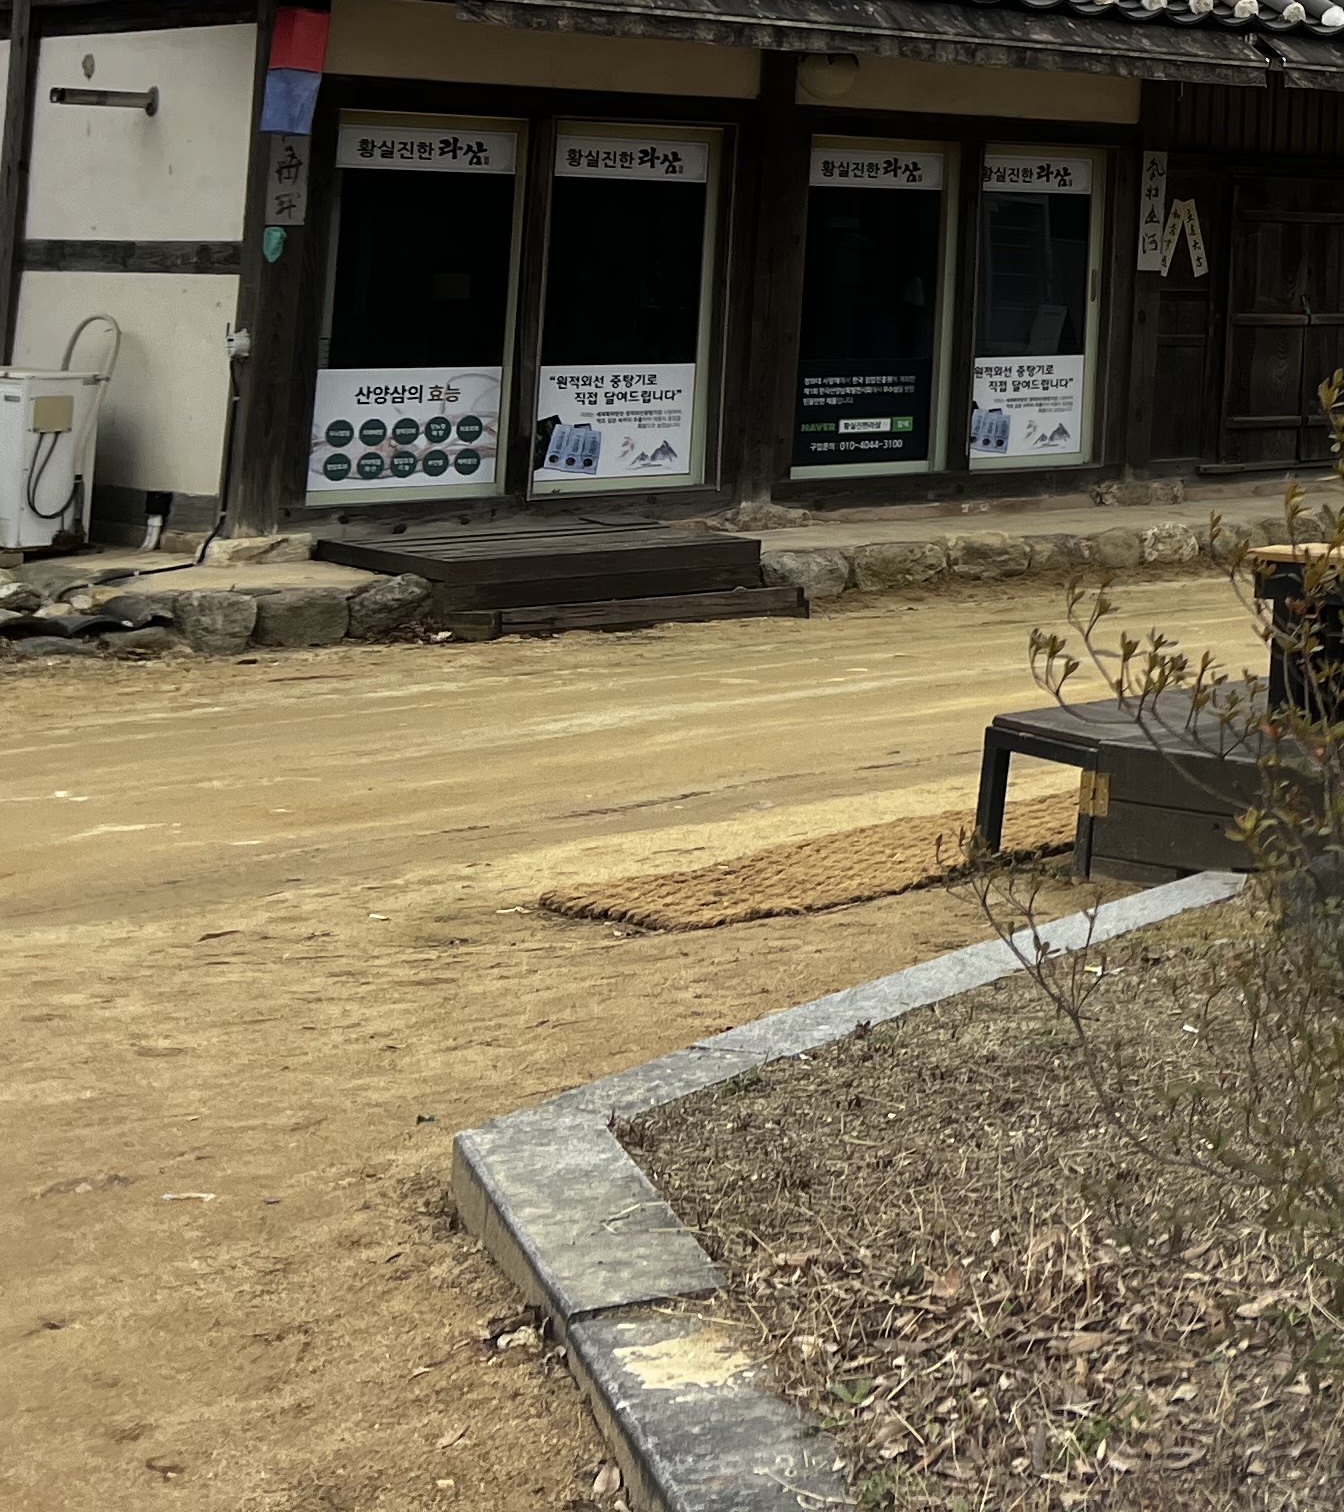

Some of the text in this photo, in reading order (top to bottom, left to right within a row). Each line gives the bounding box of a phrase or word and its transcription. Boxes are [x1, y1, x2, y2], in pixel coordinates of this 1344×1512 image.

[609, 374, 658, 389] 중탕기로
[989, 381, 1007, 392] 직접
[355, 384, 461, 405] 산양삼의 효능
[574, 392, 597, 405] 직접
